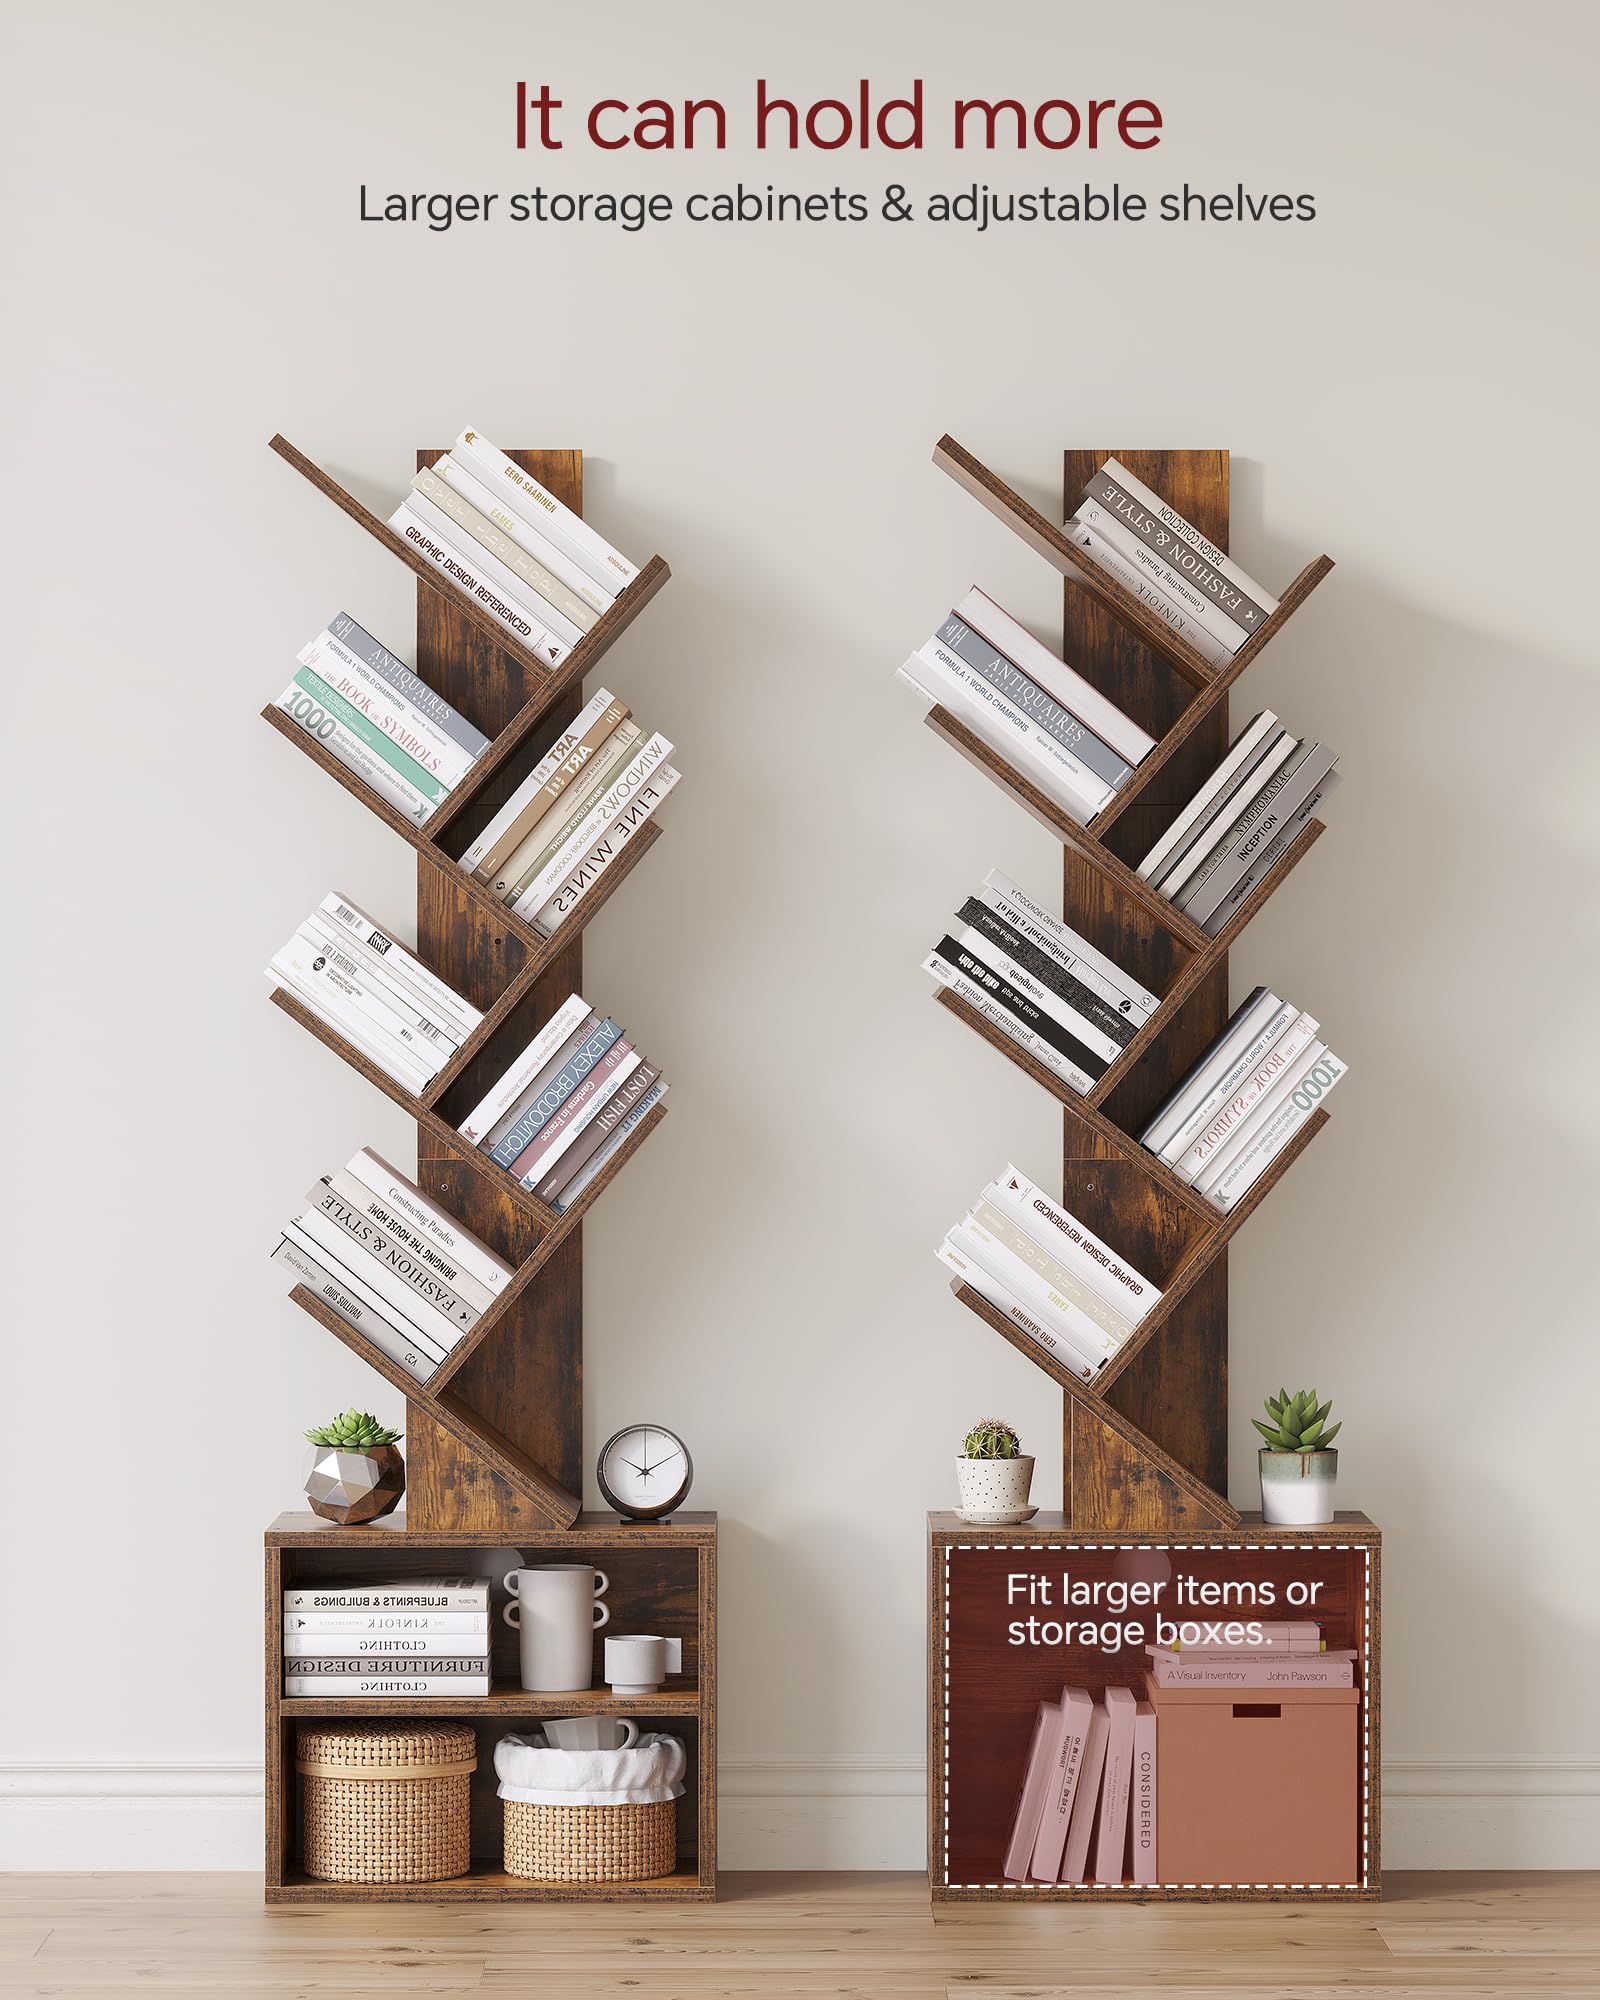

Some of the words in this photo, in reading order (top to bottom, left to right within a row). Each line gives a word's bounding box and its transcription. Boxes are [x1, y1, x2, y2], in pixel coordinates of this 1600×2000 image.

[503, 466, 524, 485] EERO
[521, 481, 557, 513] SAARINEN
[489, 507, 515, 531] EAMES
[1100, 484, 1156, 534] STYLE
[1157, 506, 1200, 544] COLLECTION
[1152, 529, 1171, 548] &
[1196, 539, 1225, 566] DESIGN
[1132, 548, 1164, 577] Paradies
[1166, 542, 1243, 610] FASHION
[403, 525, 446, 563] GRAPHIC
[442, 557, 478, 590] DESIGN
[473, 585, 533, 637] REFERENCED
[1160, 571, 1208, 613] Constructing
[1133, 582, 1186, 629] KINFOLK
[325, 640, 353, 665] FORMULA
[354, 665, 376, 685] WORLD
[373, 682, 406, 711] CHAMPIONS
[369, 646, 454, 721] ANTIQUAIRES
[934, 649, 967, 678] FORMULA
[968, 678, 993, 701] WORLD
[990, 698, 1029, 732] CHAMPIONS
[304, 673, 328, 695] TEXTILE
[324, 690, 355, 718] DESIGNERS
[985, 655, 1086, 743] ANTIQUAIRES
[281, 688, 339, 742] 1000
[323, 671, 337, 684] THE
[335, 676, 376, 714] BOOK
[369, 711, 380, 721] OF
[378, 714, 443, 772] SYMBOLS
[1234, 768, 1290, 835] NYMPHOMANIAC
[1236, 813, 1277, 861] INCEPTION
[1262, 836, 1285, 862] CEREAL
[329, 975, 352, 995] ARCHITECTURE
[347, 983, 362, 997] LIGHTING
[567, 1022, 617, 1079] ALEXEY
[567, 1079, 595, 1111] Gardens
[591, 1092, 608, 1111] URBAN
[605, 1080, 618, 1094] NEW
[619, 1064, 654, 1103] LOST
[498, 1072, 575, 1160] BRODOVITCH
[560, 1107, 572, 1119] in
[573, 1108, 594, 1133] HOUSING
[594, 1096, 627, 1132] FISH
[628, 1085, 661, 1123] MAKING
[539, 1115, 564, 1143] France
[620, 1120, 632, 1132] IT
[320, 1194, 372, 1241] STYLE
[366, 1202, 389, 1224] HOME
[385, 1186, 430, 1227] Constructing
[426, 1220, 457, 1247] Paradies
[385, 1218, 412, 1242] HOUSE
[1031, 1198, 1083, 1243] REFERENCED
[369, 1236, 387, 1253] &
[408, 1237, 425, 1254] THE
[1079, 1239, 1111, 1267] DESIGN
[385, 1249, 456, 1311] FASHION
[421, 1249, 457, 1281] BRINGING
[1107, 1262, 1144, 1296] GRAPHIC
[322, 1283, 340, 1301] LOUIS
[336, 1295, 363, 1320] SULLIVAN
[1046, 1290, 1069, 1311] EAMES
[1010, 1306, 1041, 1334] SAARINEN
[1039, 1331, 1057, 1348] EERO
[1168, 1671, 1175, 1679] A
[1176, 1671, 1203, 1680] Visual
[1205, 1671, 1246, 1682] Inventory
[1267, 1672, 1289, 1681] John
[1292, 1672, 1327, 1681] Pawson
[1140, 1752, 1150, 1848] CONSIDERED
